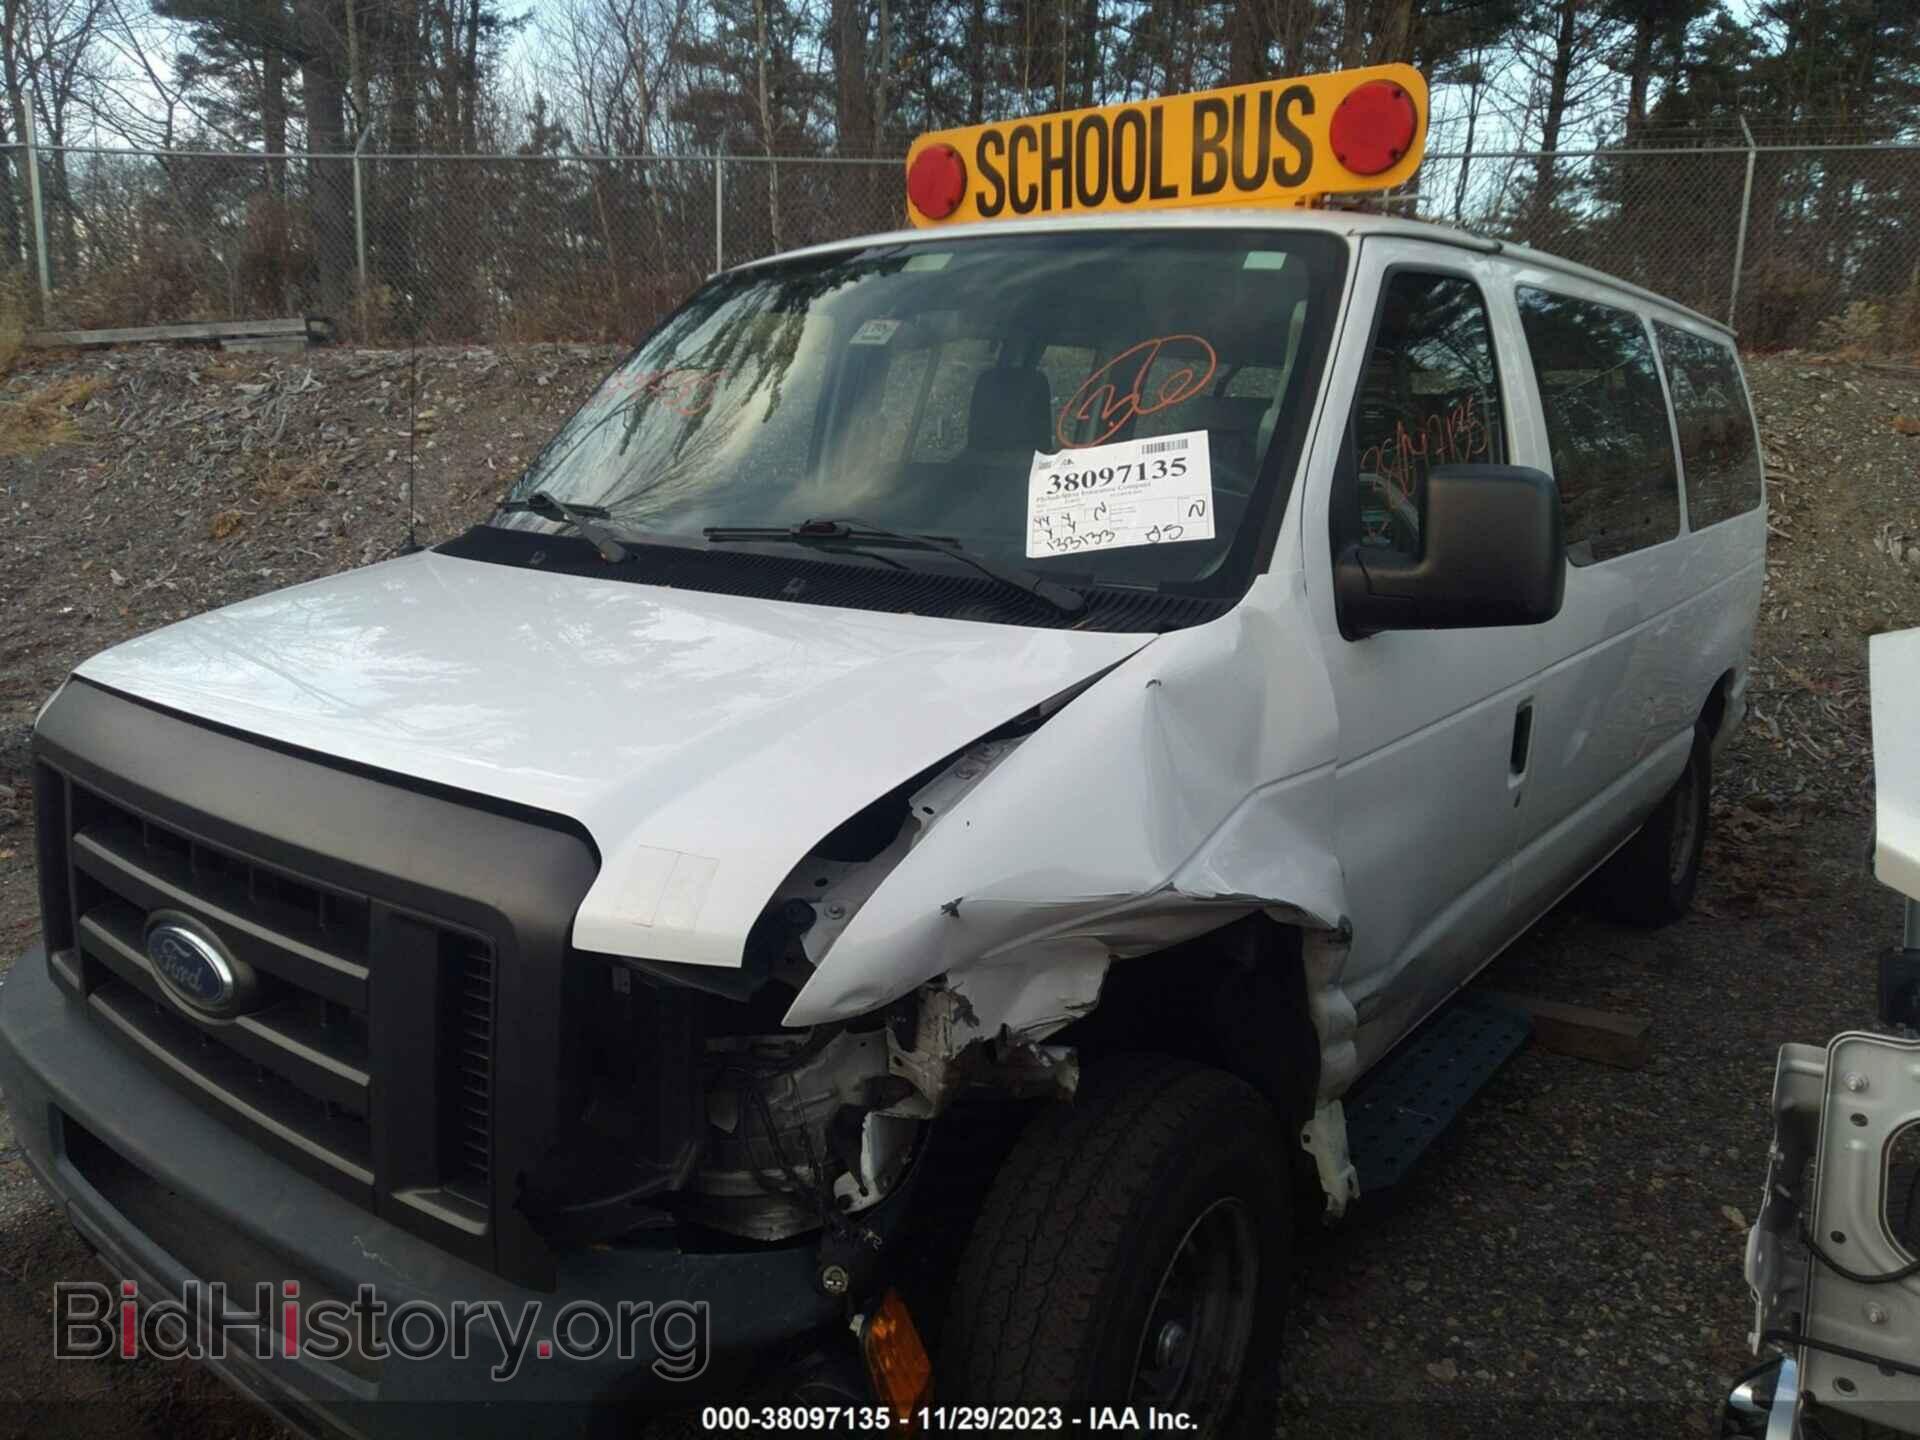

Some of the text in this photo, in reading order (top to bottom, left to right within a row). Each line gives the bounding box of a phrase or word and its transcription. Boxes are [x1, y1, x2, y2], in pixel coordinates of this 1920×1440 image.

[976, 84, 1315, 217] SCHOOL BUS
[1046, 457, 1187, 495] 38097135
[160, 938, 204, 992] Ford
